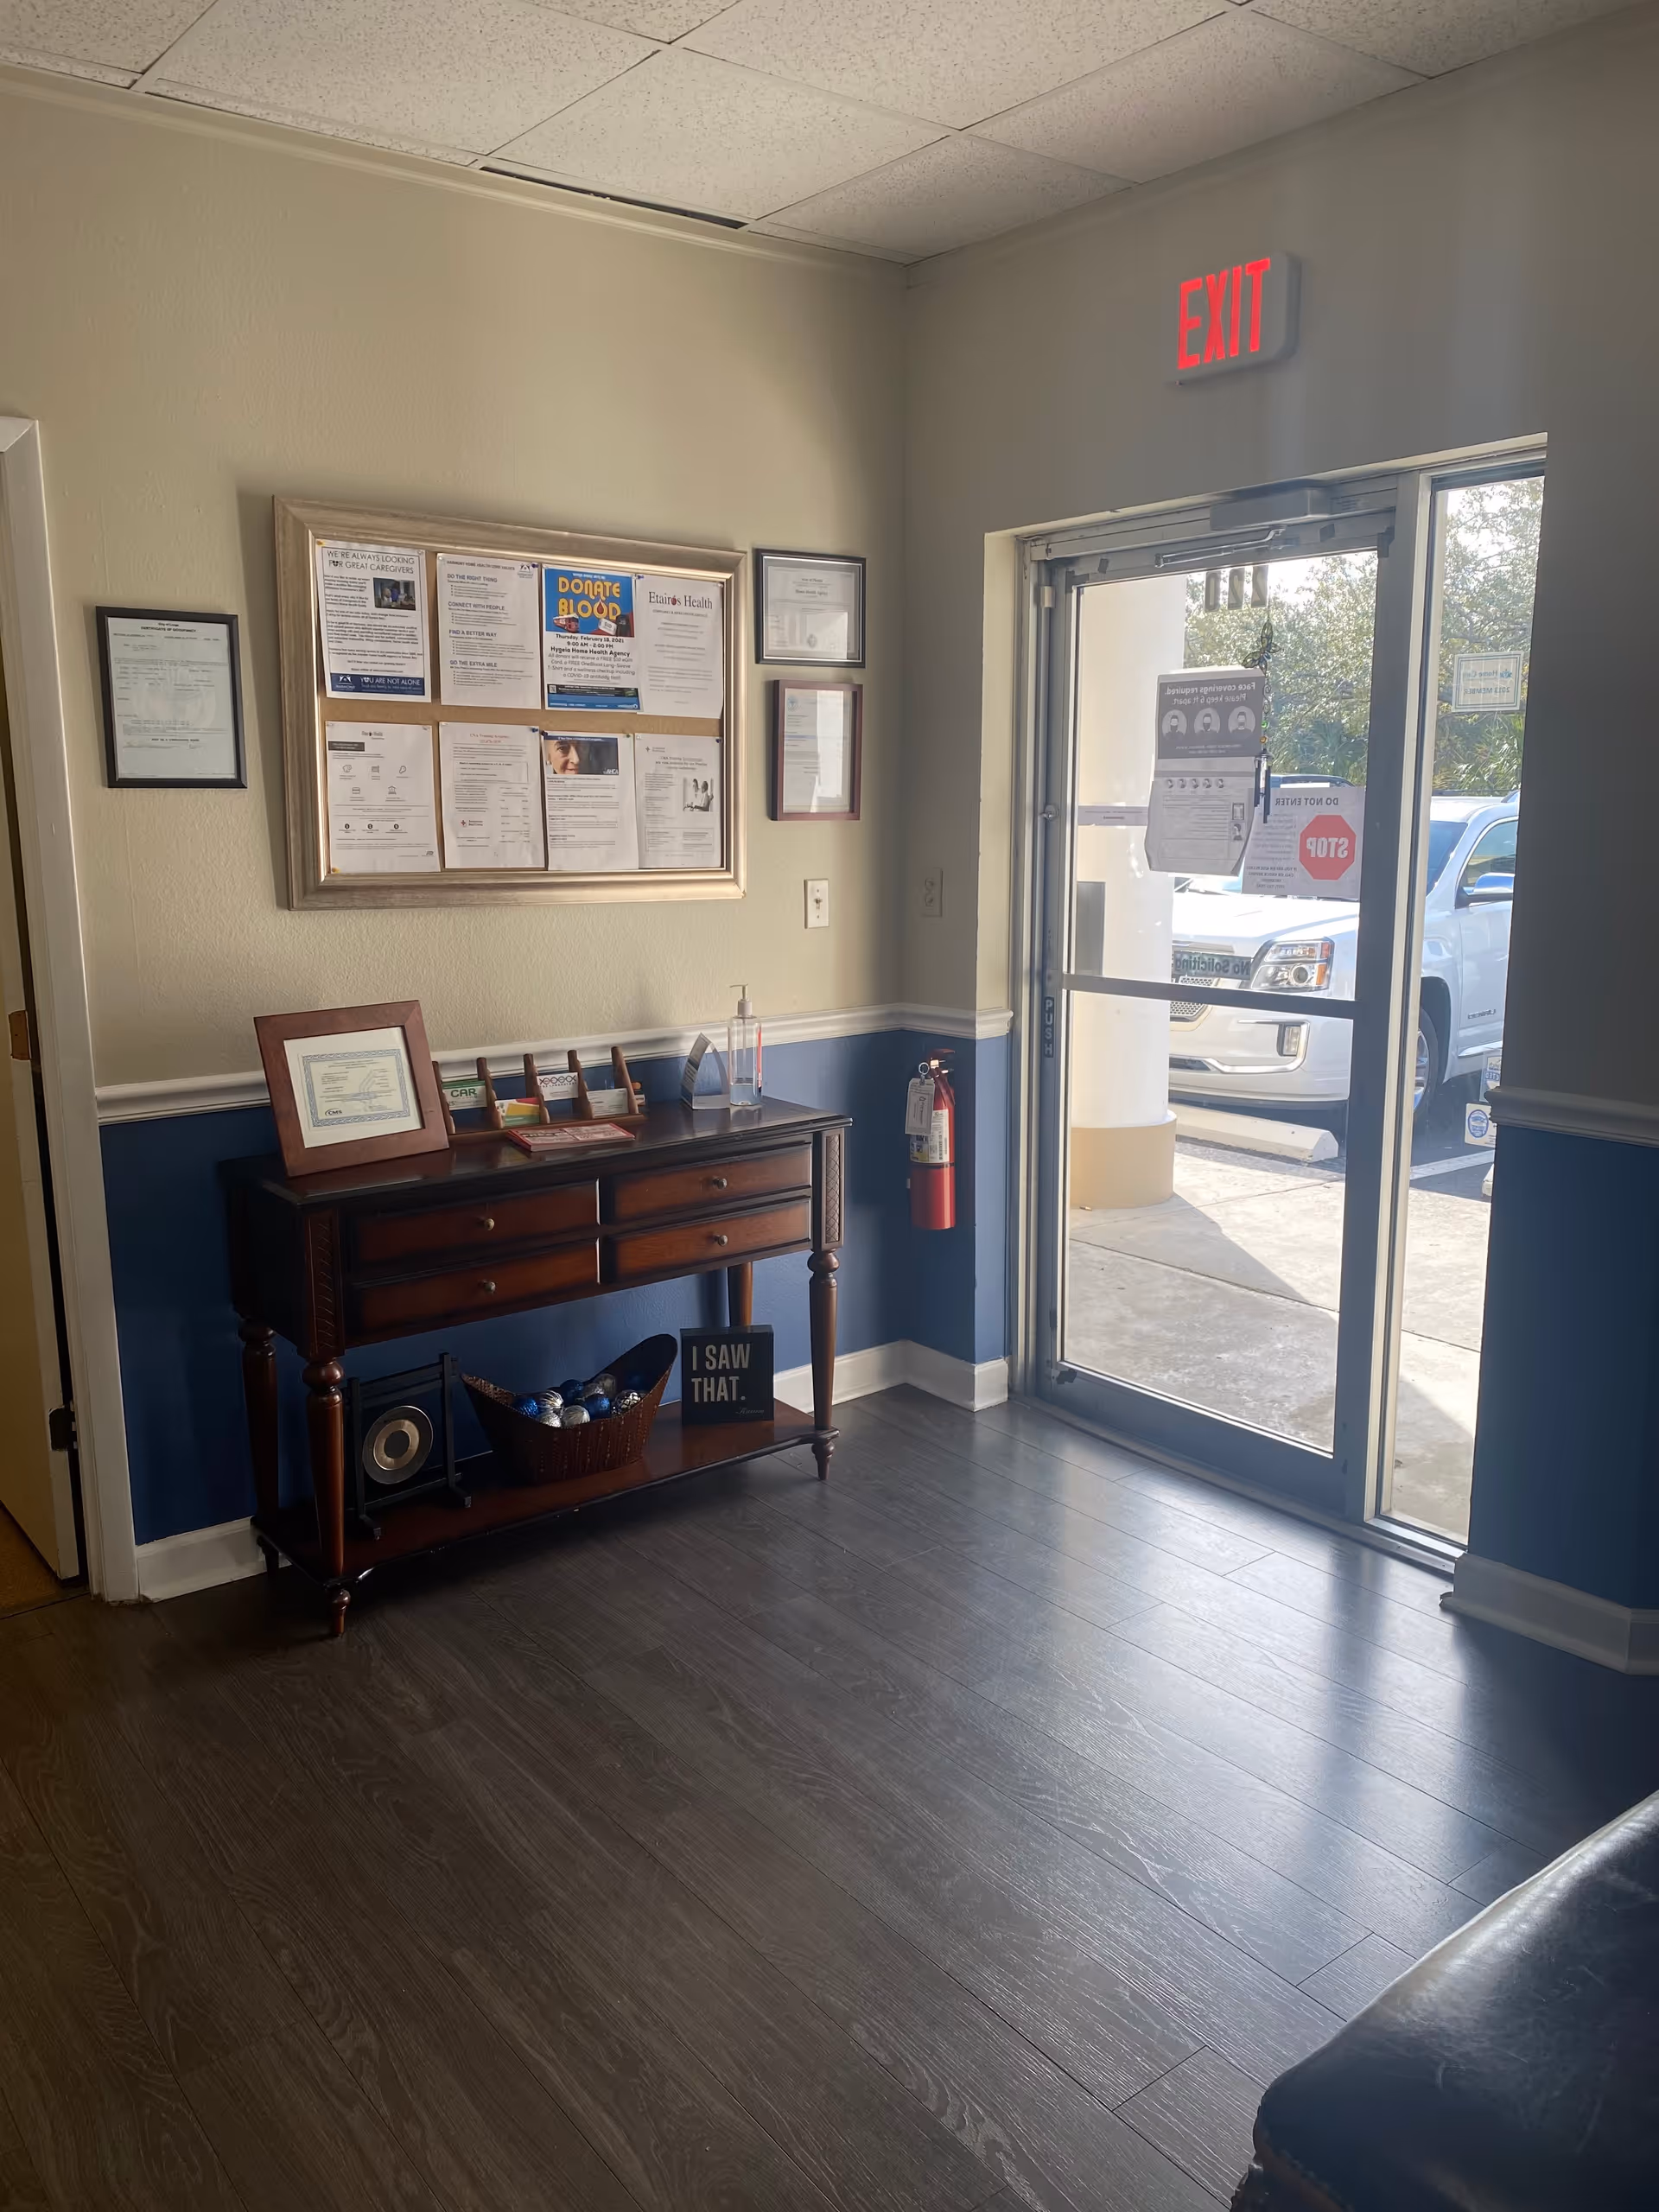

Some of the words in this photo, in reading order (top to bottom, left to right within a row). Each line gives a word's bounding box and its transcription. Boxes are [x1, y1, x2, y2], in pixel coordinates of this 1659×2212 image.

[1177, 257, 1271, 370] EXIT
[327, 550, 350, 558] WE'RE
[352, 552, 380, 562] ALWAYS
[382, 555, 415, 564] LOOKING
[370, 563, 414, 574] CAREGIVERS
[558, 576, 620, 601] DONATE
[558, 596, 621, 620] BLOOD
[684, 594, 713, 609] Health
[1045, 999, 1053, 1055] PUSH
[692, 1345, 697, 1371] I
[705, 1343, 751, 1370] SAW
[691, 1376, 746, 1402] THAT.
